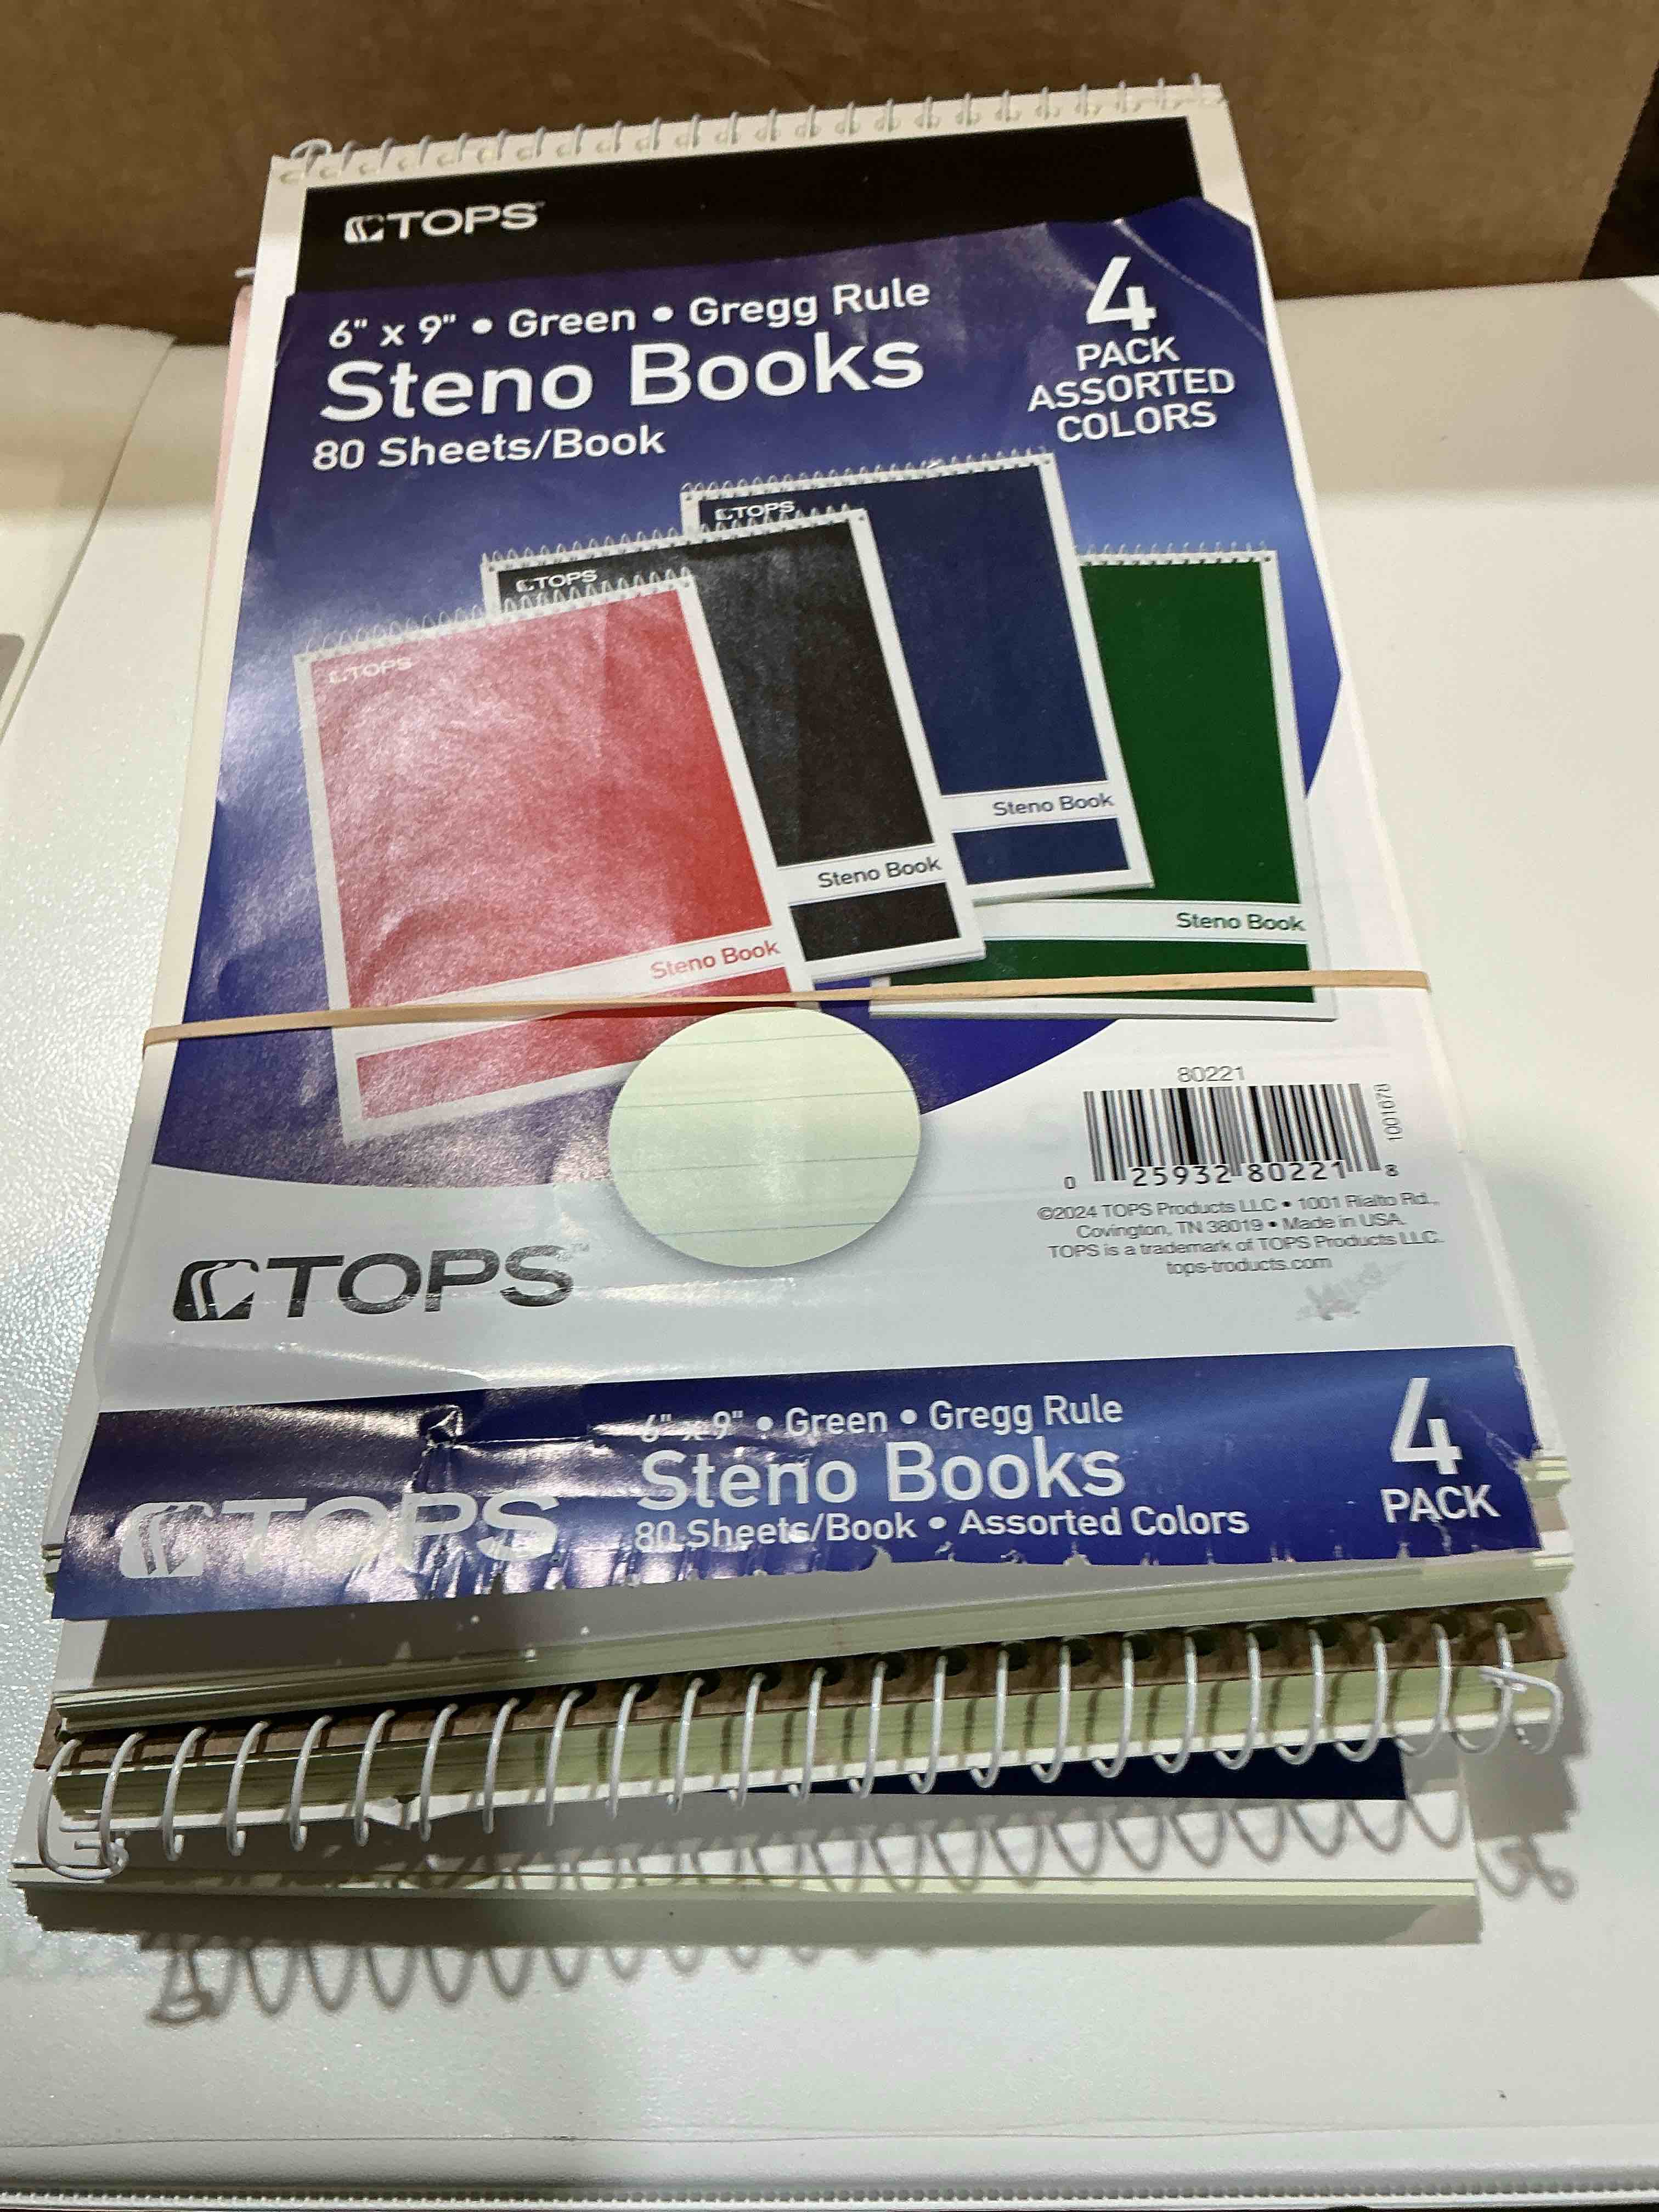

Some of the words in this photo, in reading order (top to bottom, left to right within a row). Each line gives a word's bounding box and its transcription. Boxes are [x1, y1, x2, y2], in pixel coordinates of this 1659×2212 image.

[386, 201, 538, 239] TOPS
[329, 319, 368, 349] 6"
[380, 324, 405, 347] x
[418, 313, 456, 345] 9"
[509, 307, 636, 338] Green
[689, 294, 818, 329] Gregg
[832, 277, 930, 317] Rule
[1086, 256, 1157, 331] 4
[1076, 336, 1181, 371] PACK
[320, 359, 594, 422] Steno
[630, 331, 924, 407] Books
[1028, 368, 1235, 412] ASSORTED
[1057, 400, 1217, 442] COLORS
[312, 439, 365, 471] 80
[377, 422, 666, 469] Sheets/Book
[731, 500, 795, 518] TOPS
[533, 569, 598, 589] TOPS
[346, 657, 412, 681] TOPS
[993, 799, 1054, 816] Steno
[1059, 792, 1115, 811] Book
[817, 868, 880, 889] Steno
[885, 856, 943, 877] Book
[1177, 912, 1240, 930] Steno
[1247, 913, 1306, 932] Book
[650, 953, 716, 981] Steno
[721, 940, 781, 964] Book
[1177, 1066, 1245, 1082] 80221
[1131, 1164, 1232, 1187] 25932
[1248, 1161, 1346, 1182] 80221
[1385, 1164, 1400, 1177] 8
[1102, 1203, 1153, 1217] TOPS
[1156, 1200, 1236, 1215] Products
[1238, 1198, 1278, 1212] LLC
[1298, 1196, 1340, 1210] 1001
[1175, 1221, 1203, 1234] TN
[1207, 1218, 1263, 1233] 38019
[1282, 1216, 1335, 1230] Made
[1338, 1214, 1357, 1228] in
[1047, 1244, 1100, 1259] TOPS
[1104, 1243, 1119, 1256] is
[1125, 1245, 1136, 1255] a
[1140, 1239, 1232, 1255] trademark
[1235, 1238, 1254, 1251] of
[1257, 1235, 1312, 1251] TOPS
[1313, 1233, 1397, 1248] Products
[267, 1244, 574, 1318] TOPS
[641, 1413, 672, 1443] 6"
[682, 1422, 703, 1441] x
[713, 1410, 744, 1440] 9"
[786, 1407, 888, 1436] Green
[929, 1400, 1034, 1436] Gregg
[1043, 1393, 1124, 1426] Rule
[1390, 1378, 1462, 1475] 4
[637, 1449, 857, 1511] Steno
[885, 1435, 1125, 1502] Books
[1380, 1484, 1501, 1523] PACK
[221, 1490, 560, 1575] TOPS
[634, 1520, 676, 1553] 80
[686, 1512, 918, 1549] Sheets/Book
[958, 1506, 1122, 1536] Assorted
[1130, 1504, 1250, 1536] Colors
